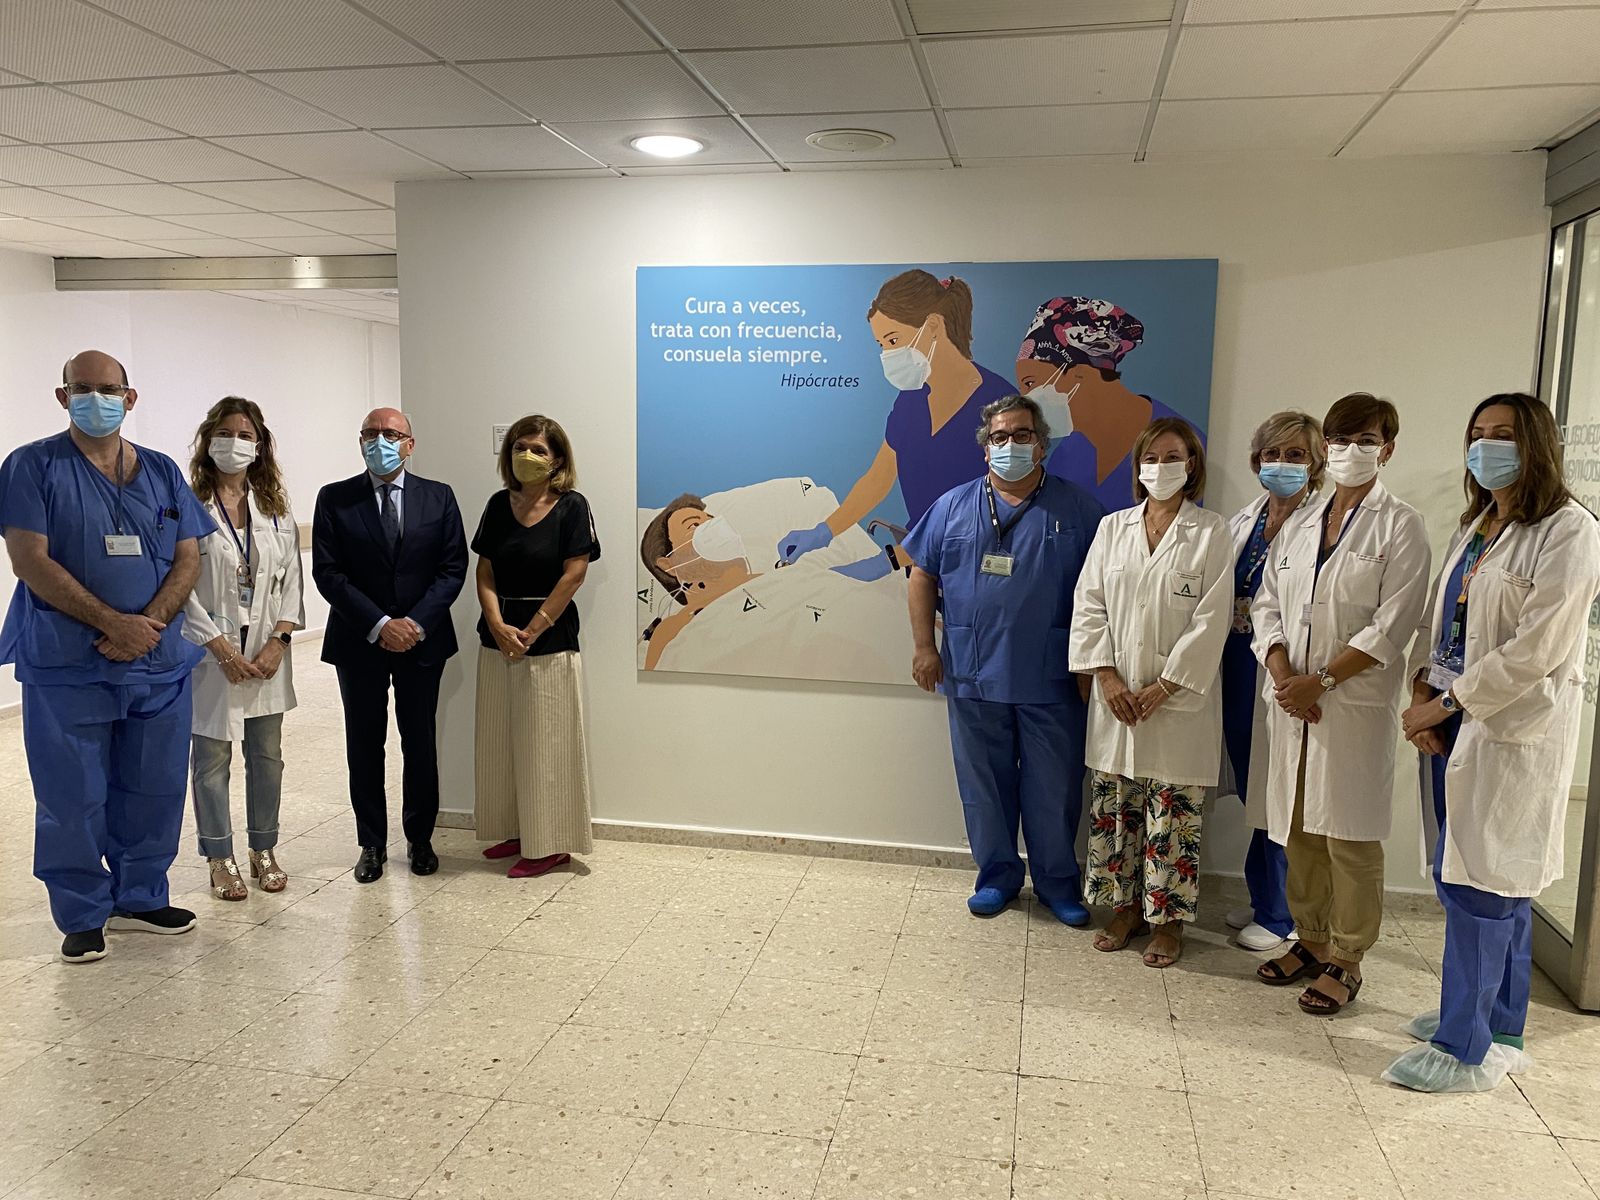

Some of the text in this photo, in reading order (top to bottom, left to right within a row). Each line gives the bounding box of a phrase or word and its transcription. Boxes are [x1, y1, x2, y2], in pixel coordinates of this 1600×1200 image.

[684, 296, 807, 317] Cura a veces,
[650, 321, 843, 342] trata con frecuencia,
[663, 345, 829, 366] consuela siempre.
[780, 372, 860, 390] Hipócrates
